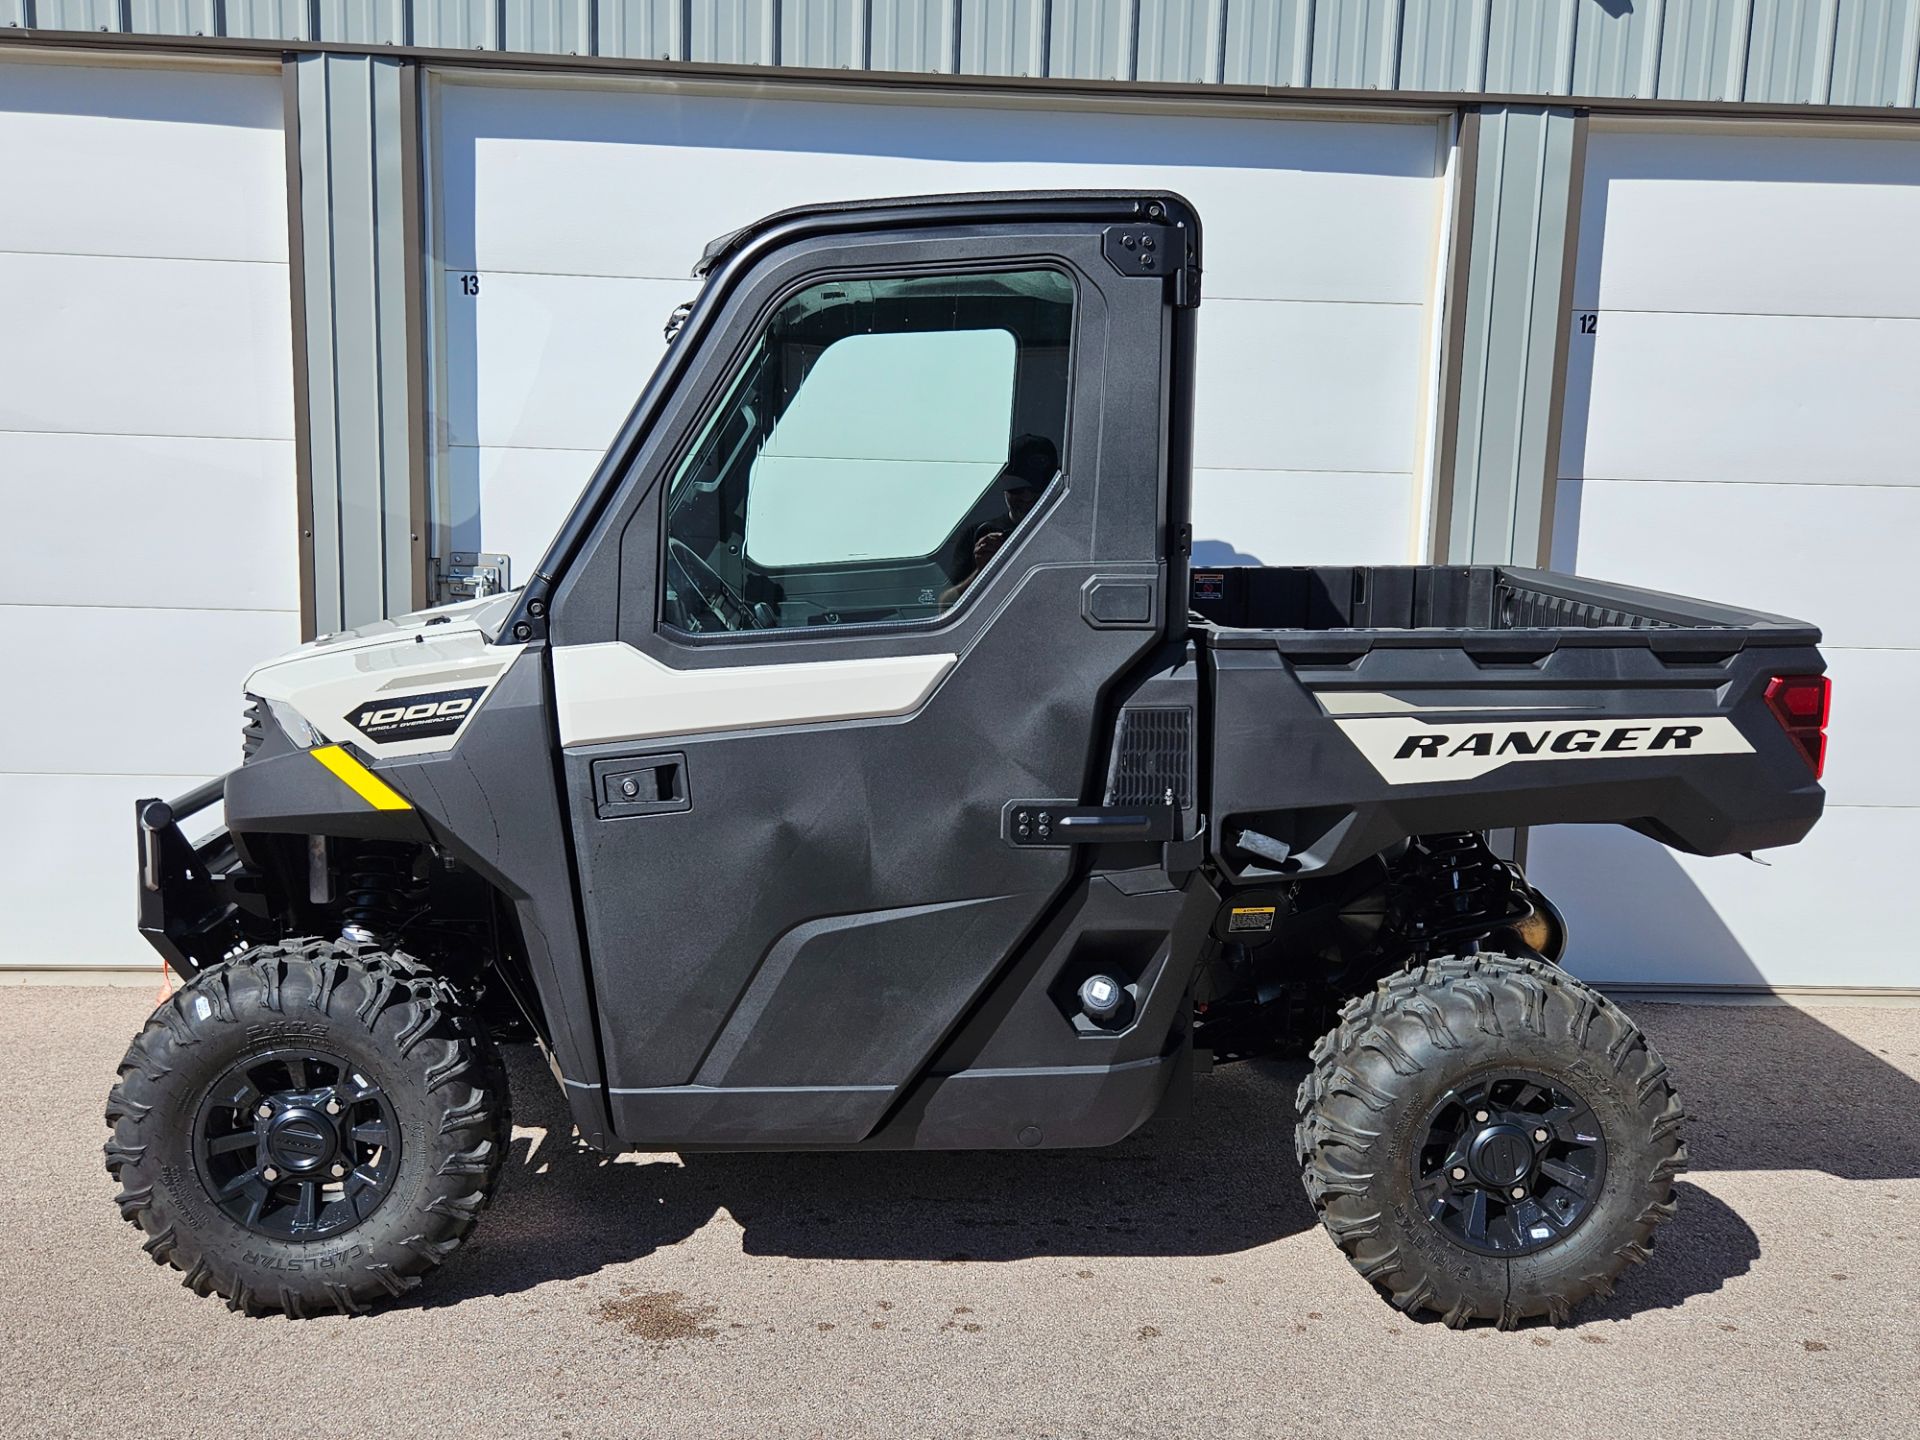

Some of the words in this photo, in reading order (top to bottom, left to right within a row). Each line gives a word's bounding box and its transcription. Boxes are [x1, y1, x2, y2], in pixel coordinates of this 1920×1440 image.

[460, 275, 480, 295] 13
[1579, 314, 1598, 334] 12
[358, 698, 473, 727] 1000
[366, 724, 397, 732] SINGLE
[399, 717, 445, 727] OVERHEAD
[1393, 725, 1704, 759] RANGER
[242, 1244, 365, 1272] CARLSTAR
